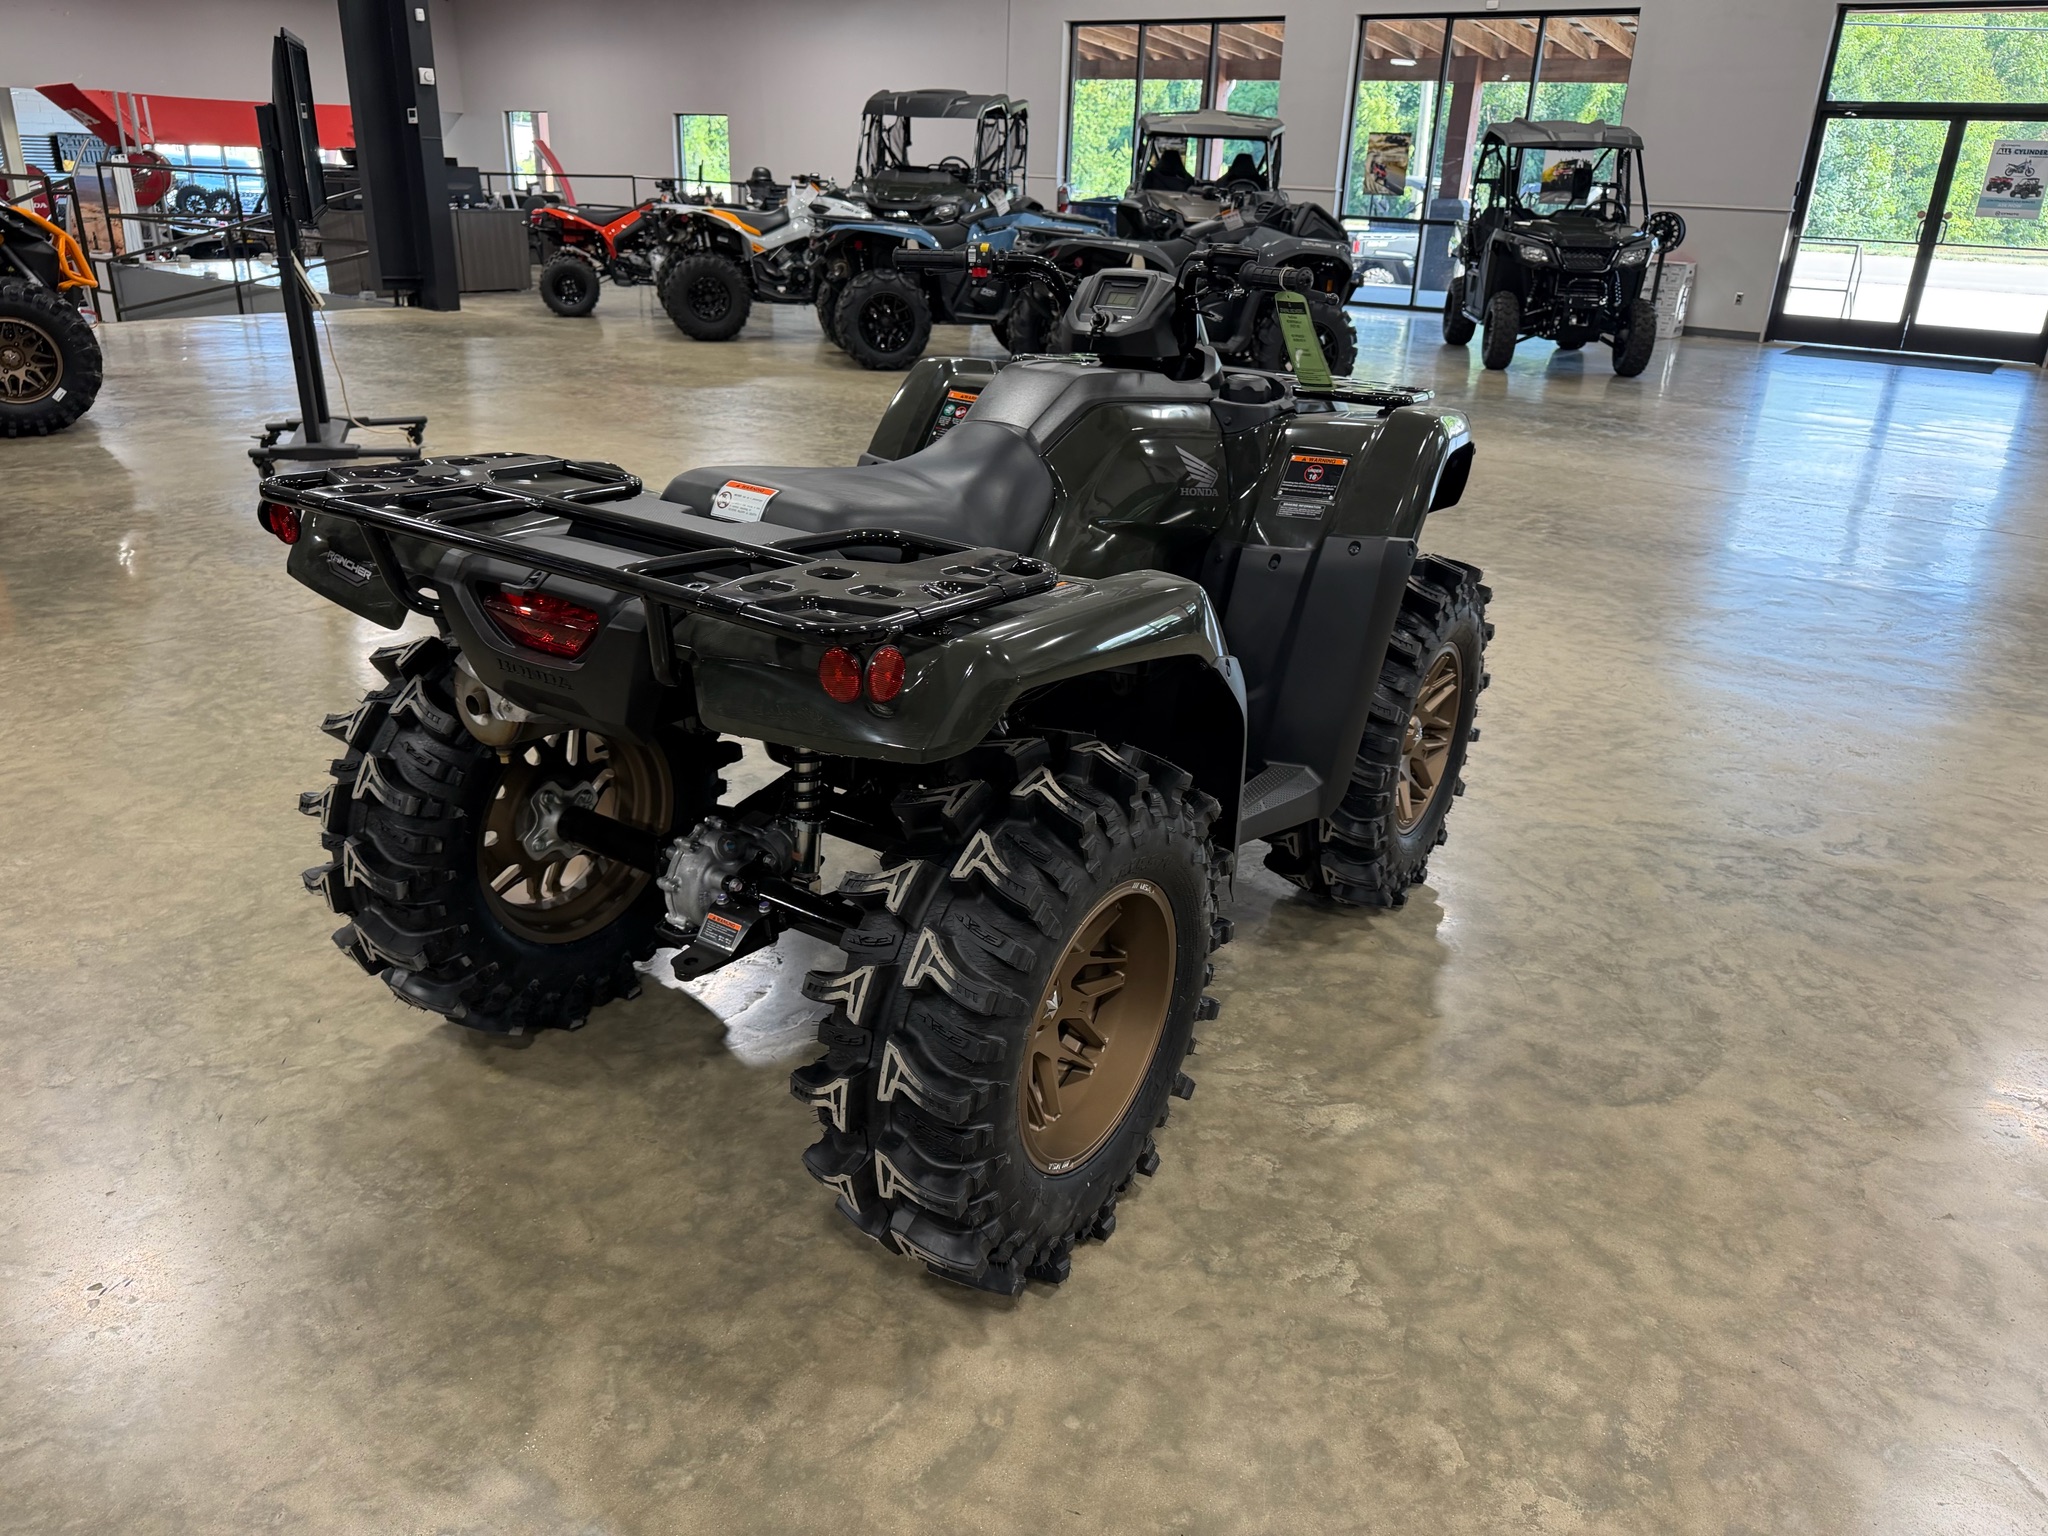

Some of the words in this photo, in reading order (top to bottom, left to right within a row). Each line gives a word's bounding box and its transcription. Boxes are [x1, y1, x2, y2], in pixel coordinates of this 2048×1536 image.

[742, 485, 765, 493] WARNING
[1180, 487, 1219, 496] HONDA
[327, 550, 372, 580] RANCHER
[497, 658, 575, 690] HONDA
[717, 917, 736, 928] WARNING
